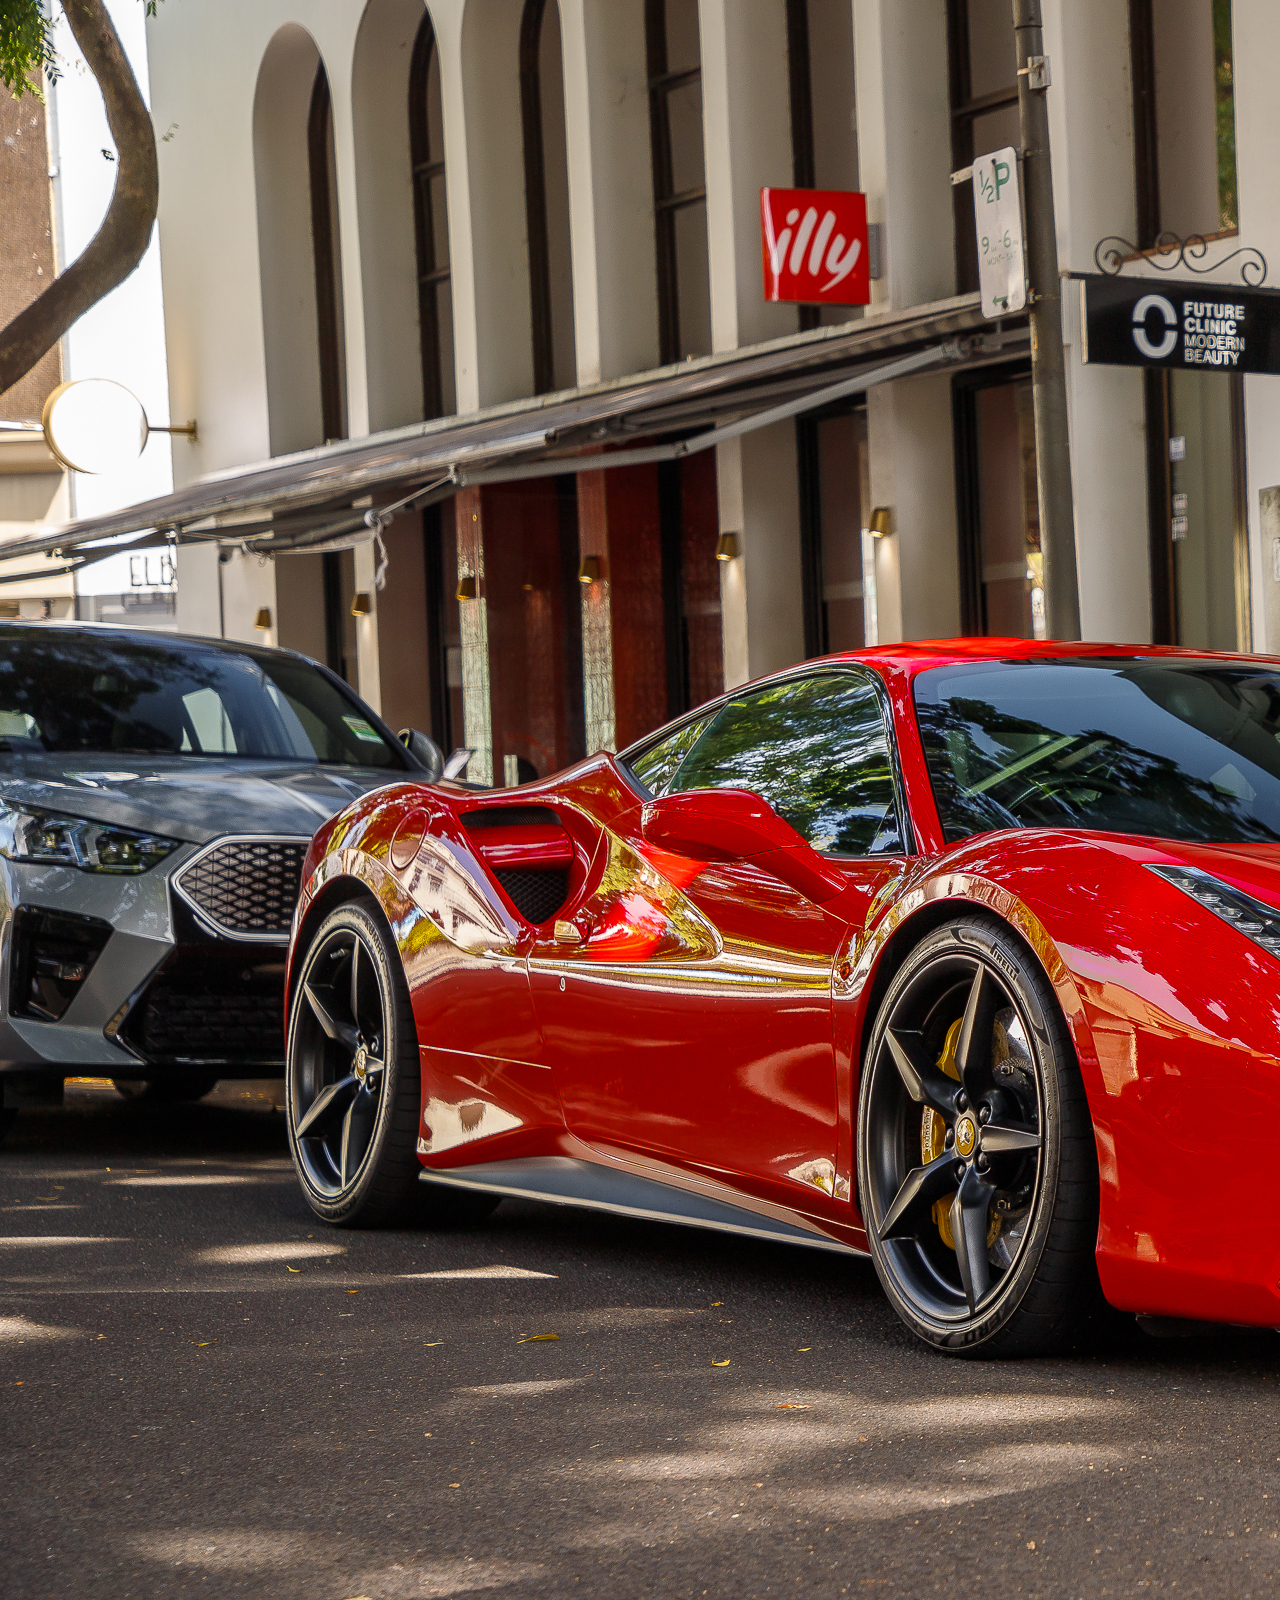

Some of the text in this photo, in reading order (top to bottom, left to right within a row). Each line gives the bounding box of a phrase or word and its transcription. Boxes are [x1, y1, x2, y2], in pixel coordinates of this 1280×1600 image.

[771, 206, 862, 292] illy
[1183, 301, 1245, 320] FUTURE
[1184, 317, 1237, 335] CLINIC
[1184, 333, 1246, 351] MODERN
[1184, 348, 1240, 365] BEAUTY
[989, 941, 1020, 982] PIRELLI
